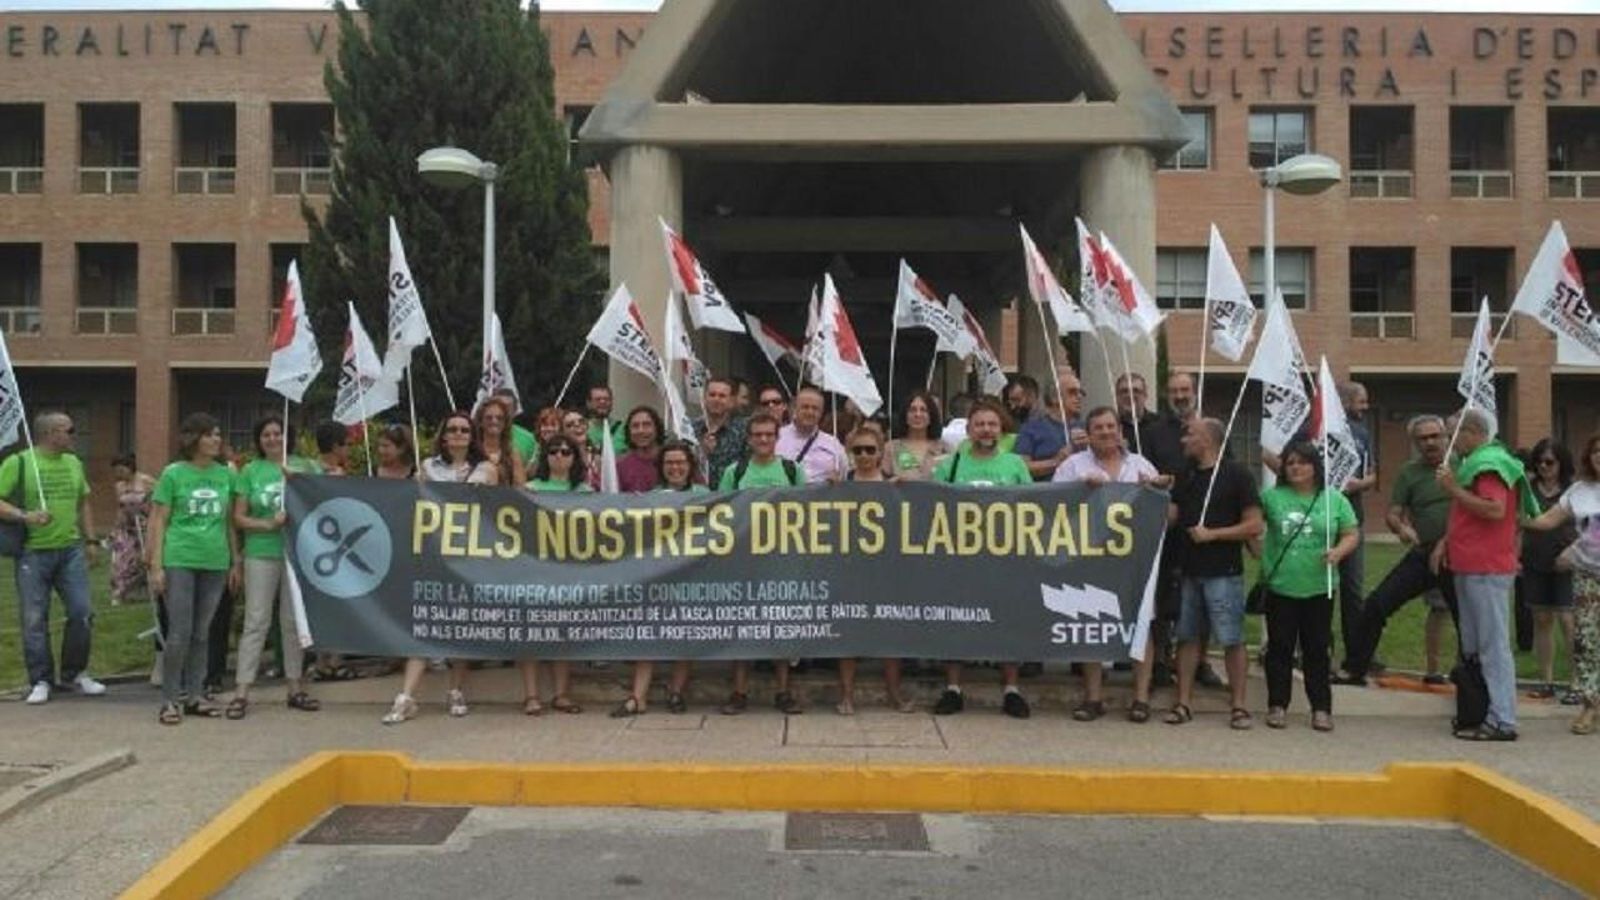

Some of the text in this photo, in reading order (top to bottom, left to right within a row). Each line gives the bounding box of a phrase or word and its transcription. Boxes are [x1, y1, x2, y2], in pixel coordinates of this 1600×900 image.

[1151, 65, 1402, 99] ULTURA
[1450, 67, 1457, 98] I
[412, 499, 1134, 561] PELS NOSTRES DRETS LABORALS
[413, 579, 830, 604] PER LA RECUPERACIÓ DE LES CONDICIONS LABORALS
[412, 604, 428, 620] UN
[430, 605, 469, 621] SALARI
[645, 605, 659, 621] DE
[663, 605, 678, 621] LA
[679, 605, 713, 621] TASCA
[761, 603, 813, 620] REDUCCIÓ
[816, 604, 829, 620] DE
[873, 604, 921, 620] JORNADA
[412, 624, 428, 638] NO
[430, 624, 451, 639] ALS
[508, 626, 523, 641] DE
[636, 625, 657, 640] DEL
[659, 625, 734, 640] PROFESSORAT
[1050, 622, 1137, 645] STEPV
